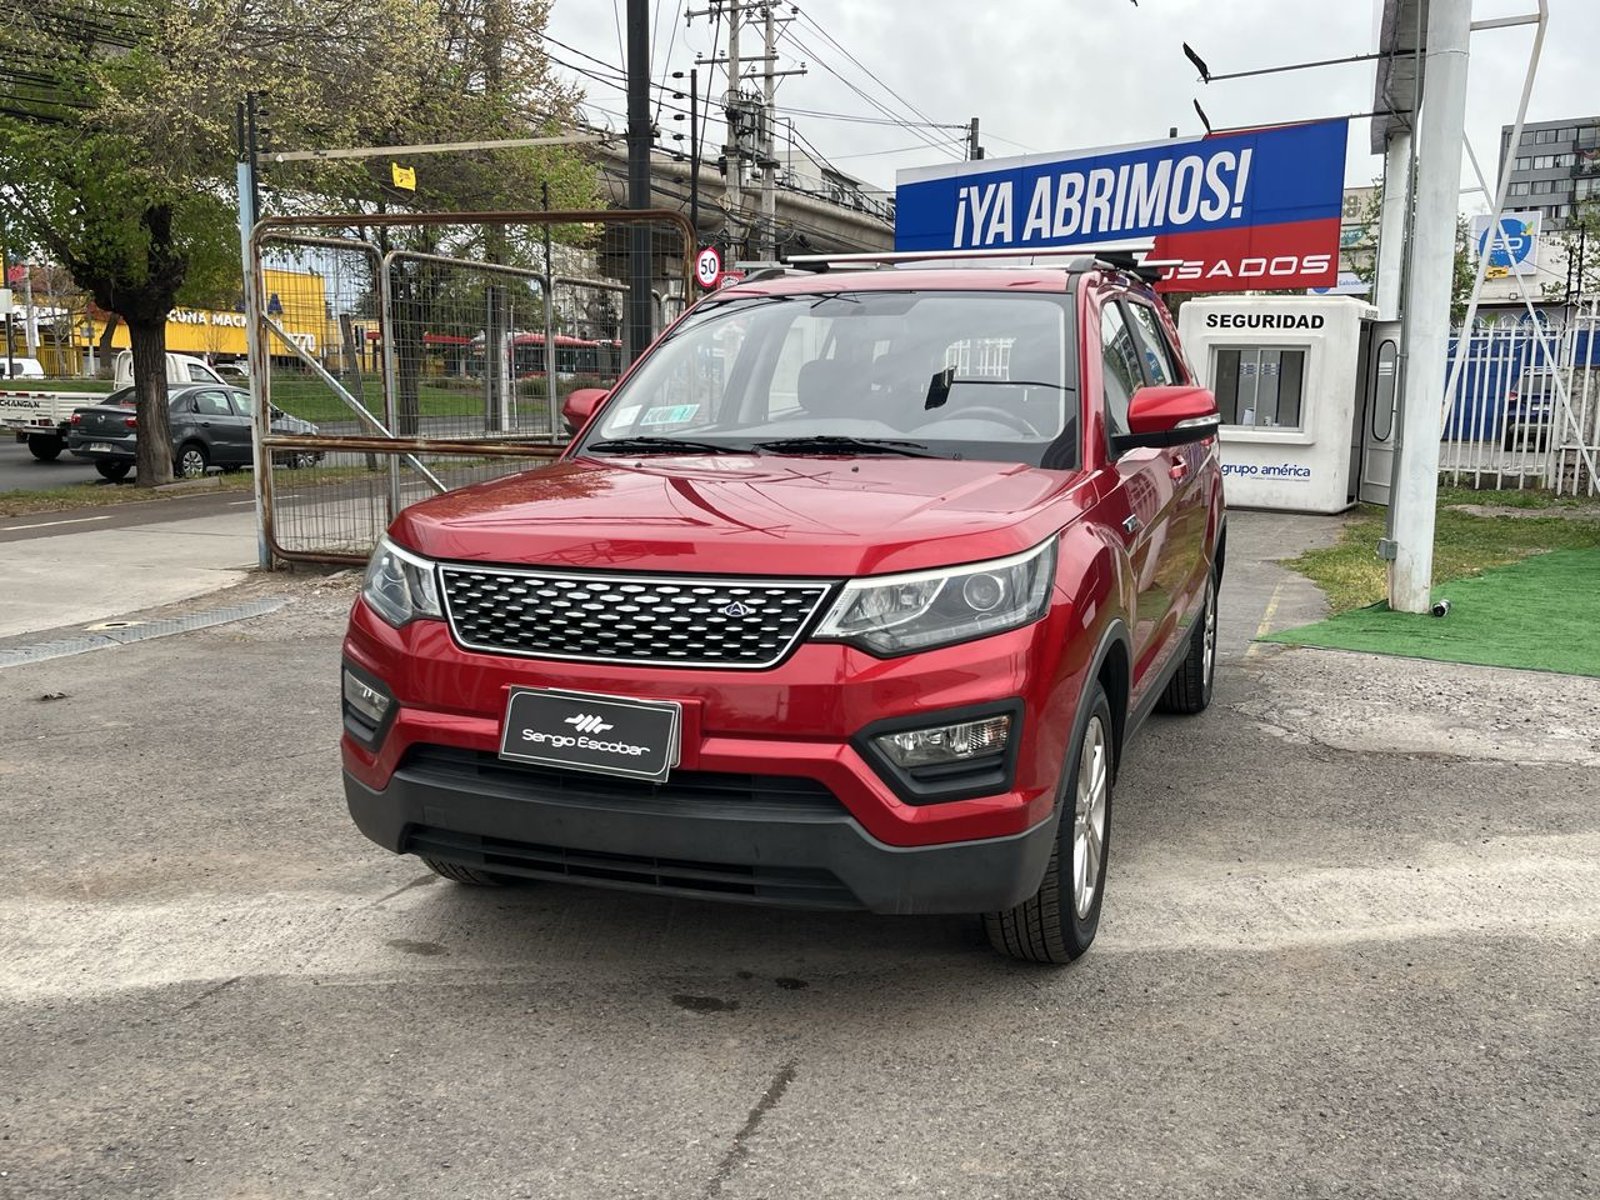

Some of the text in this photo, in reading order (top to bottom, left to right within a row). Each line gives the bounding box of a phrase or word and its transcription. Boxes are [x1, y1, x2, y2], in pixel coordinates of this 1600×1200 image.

[1022, 148, 1252, 241] ABRIMOS!
[701, 257, 716, 275] 50
[1206, 313, 1325, 330] SEGURIDAD
[0, 399, 40, 408] CHANGAN
[1220, 463, 1311, 477] grupo américa
[577, 736, 651, 756] Escobar
